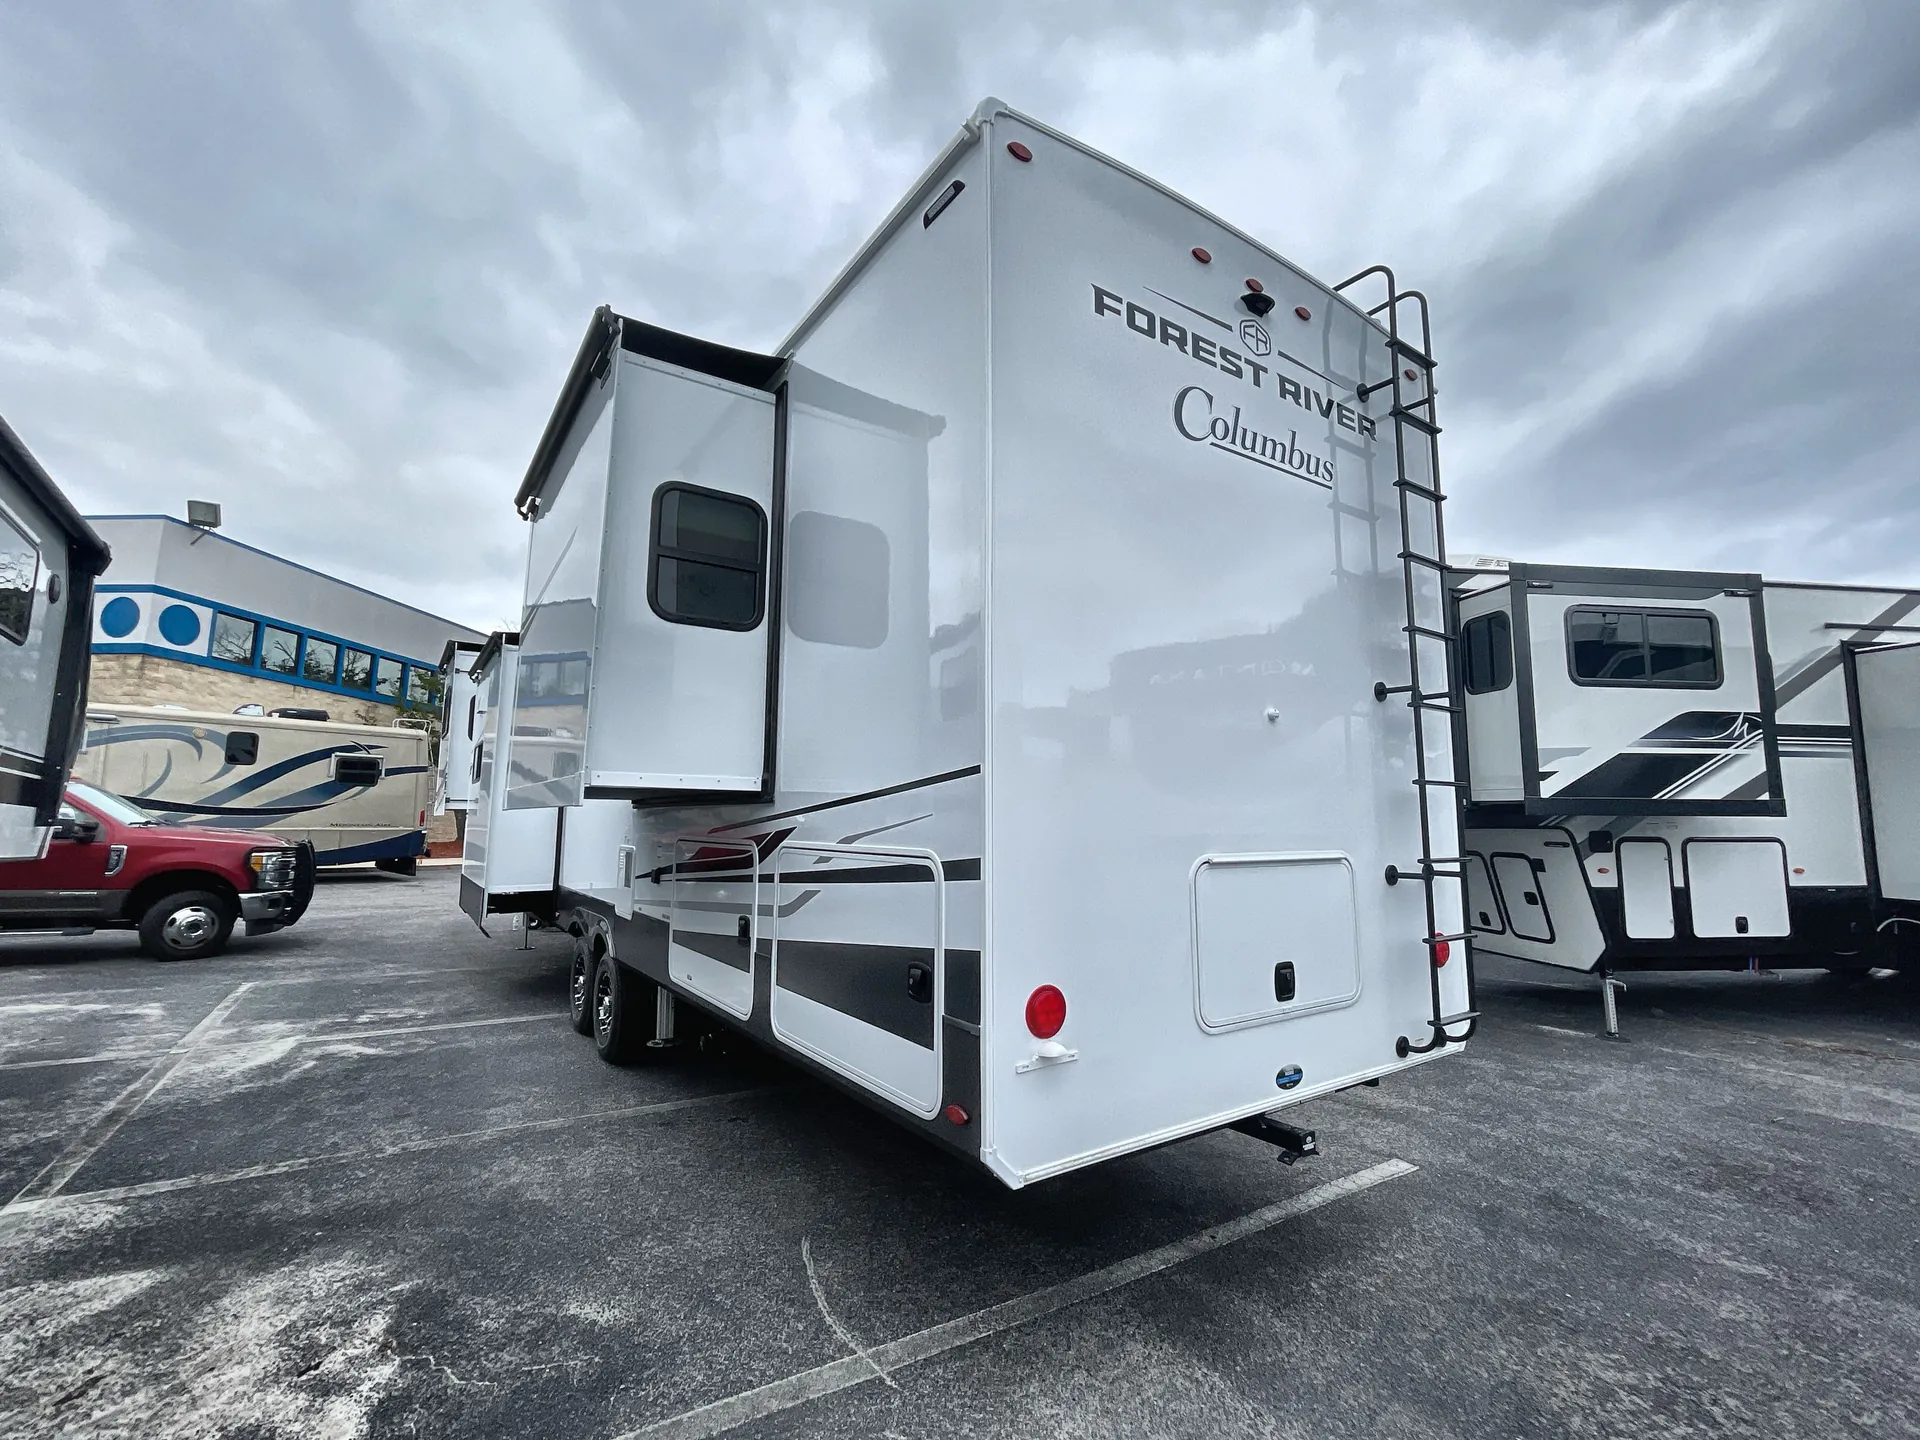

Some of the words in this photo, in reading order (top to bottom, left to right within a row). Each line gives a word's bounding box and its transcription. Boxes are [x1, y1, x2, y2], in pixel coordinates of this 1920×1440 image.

[1090, 283, 1269, 389] FOREST
[1276, 372, 1378, 443] RIVER
[1172, 385, 1334, 483] Columbus
